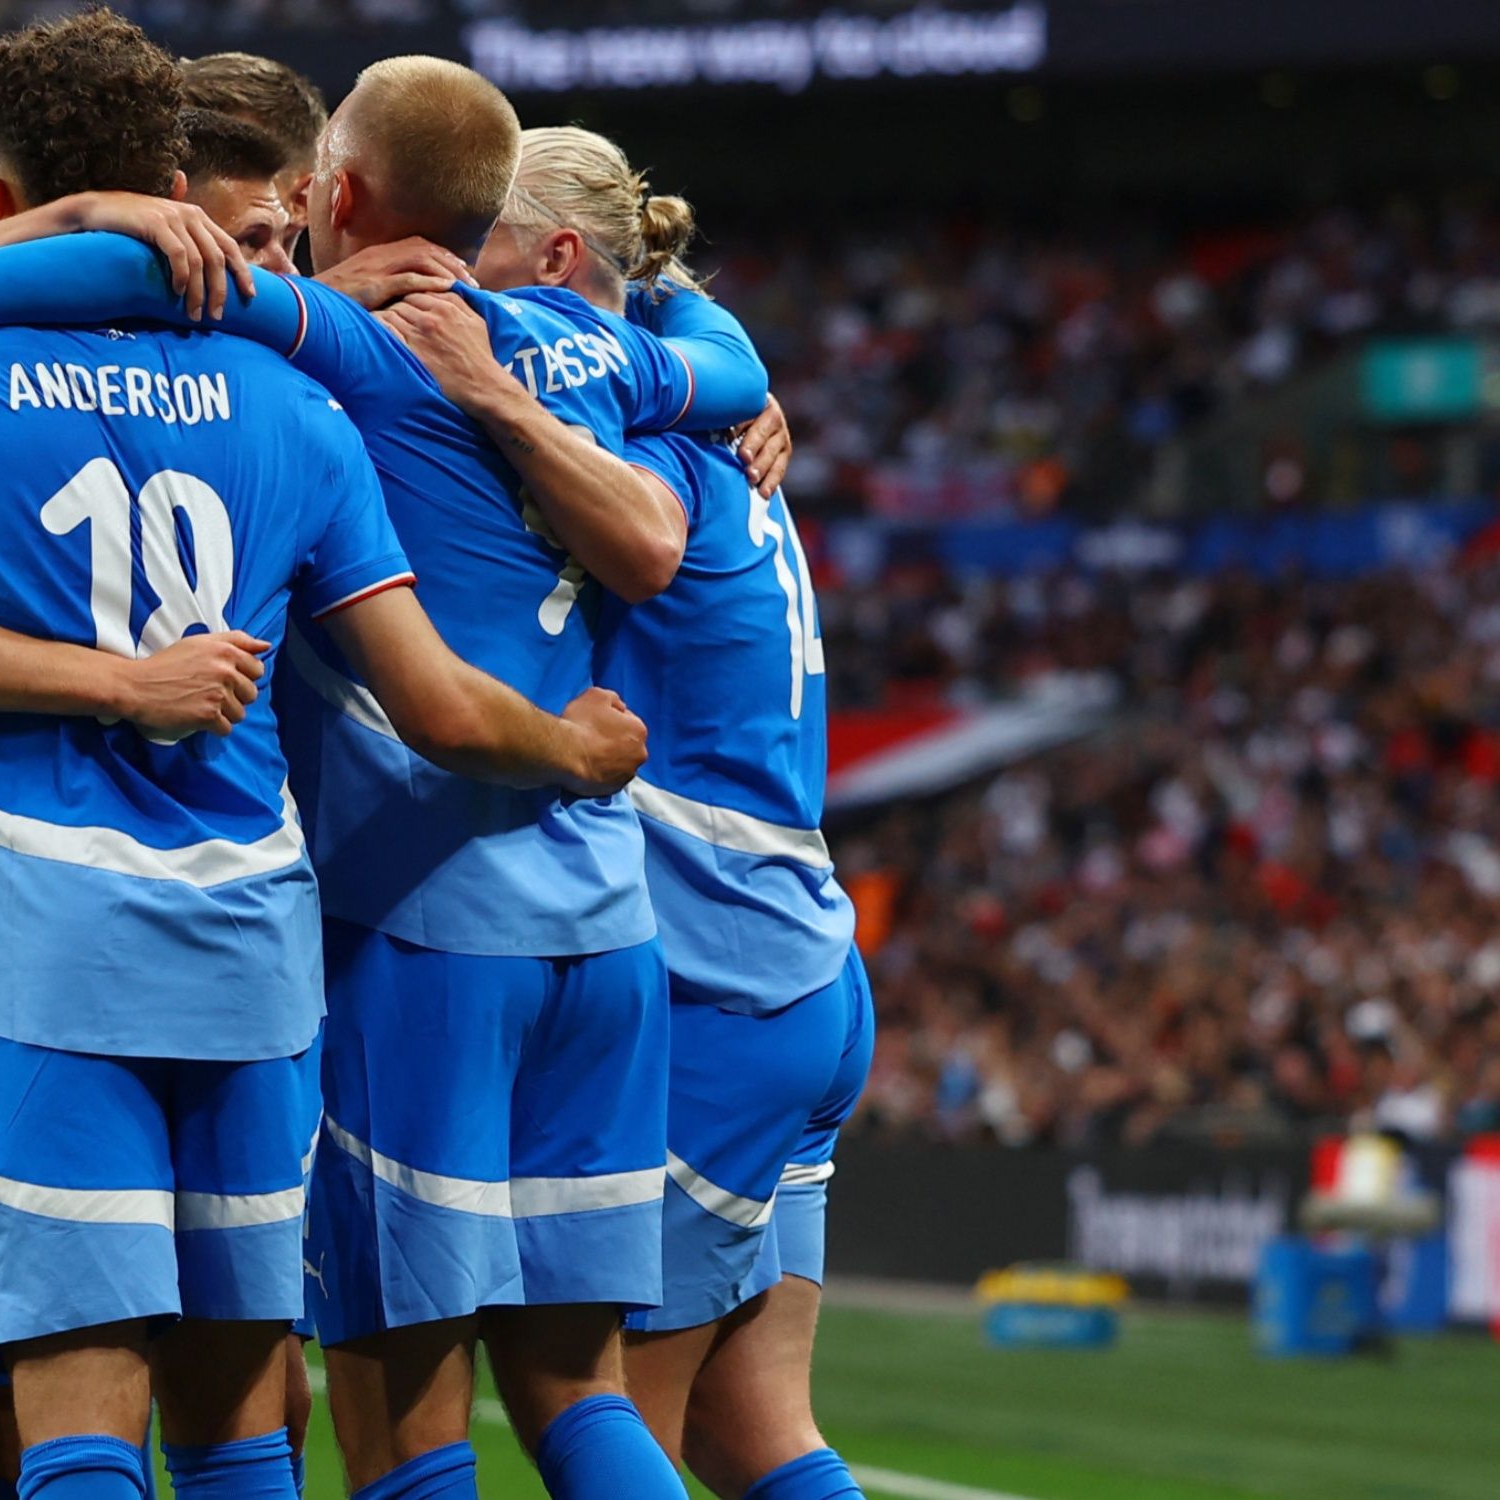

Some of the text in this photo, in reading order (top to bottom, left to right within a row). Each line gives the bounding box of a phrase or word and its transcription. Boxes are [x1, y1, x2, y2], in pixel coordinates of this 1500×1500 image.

[469, 4, 1043, 92] The new way to cloud
[9, 362, 231, 426] ANDERSON
[40, 457, 234, 745] 18
